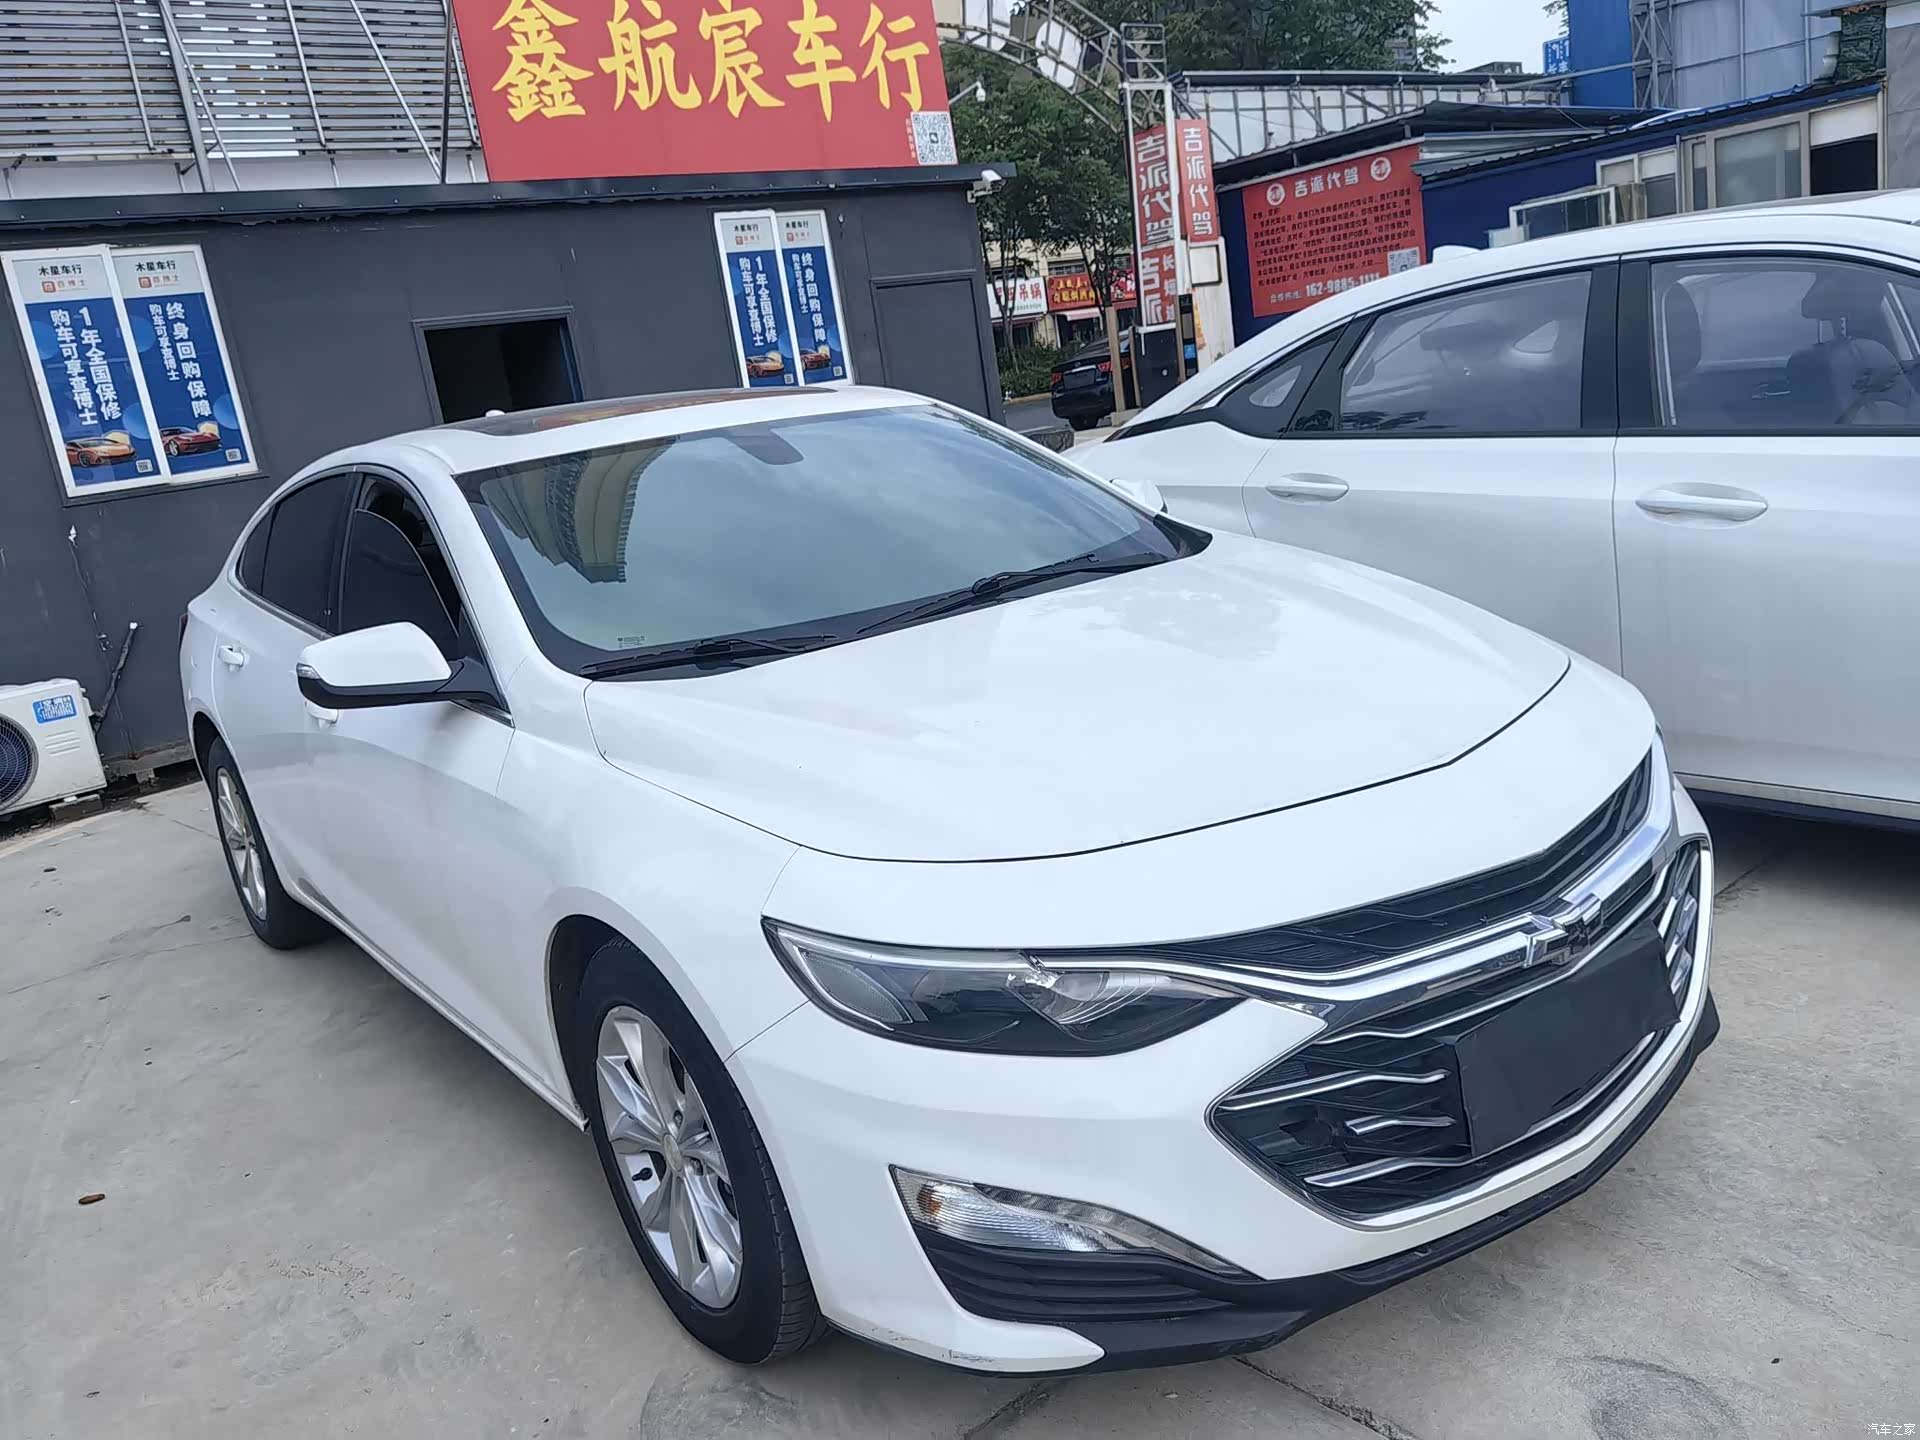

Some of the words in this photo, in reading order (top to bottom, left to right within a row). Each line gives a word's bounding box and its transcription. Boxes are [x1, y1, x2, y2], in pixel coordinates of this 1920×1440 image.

[491, 0, 930, 123] 鑫航宸车行
[1135, 134, 1174, 244] 吉派代驾
[1183, 127, 1213, 236] 吉派代驾
[1294, 166, 1359, 198] 吉派代驾
[39, 264, 83, 276] 木星车行
[135, 260, 176, 272] 木星车行
[755, 256, 778, 343] 1年全国保修
[801, 252, 827, 342] 终身回购保障
[49, 308, 98, 426] 购车可享查博士
[78, 306, 122, 421] 1年全国保修
[166, 302, 213, 418] 终身回购保障
